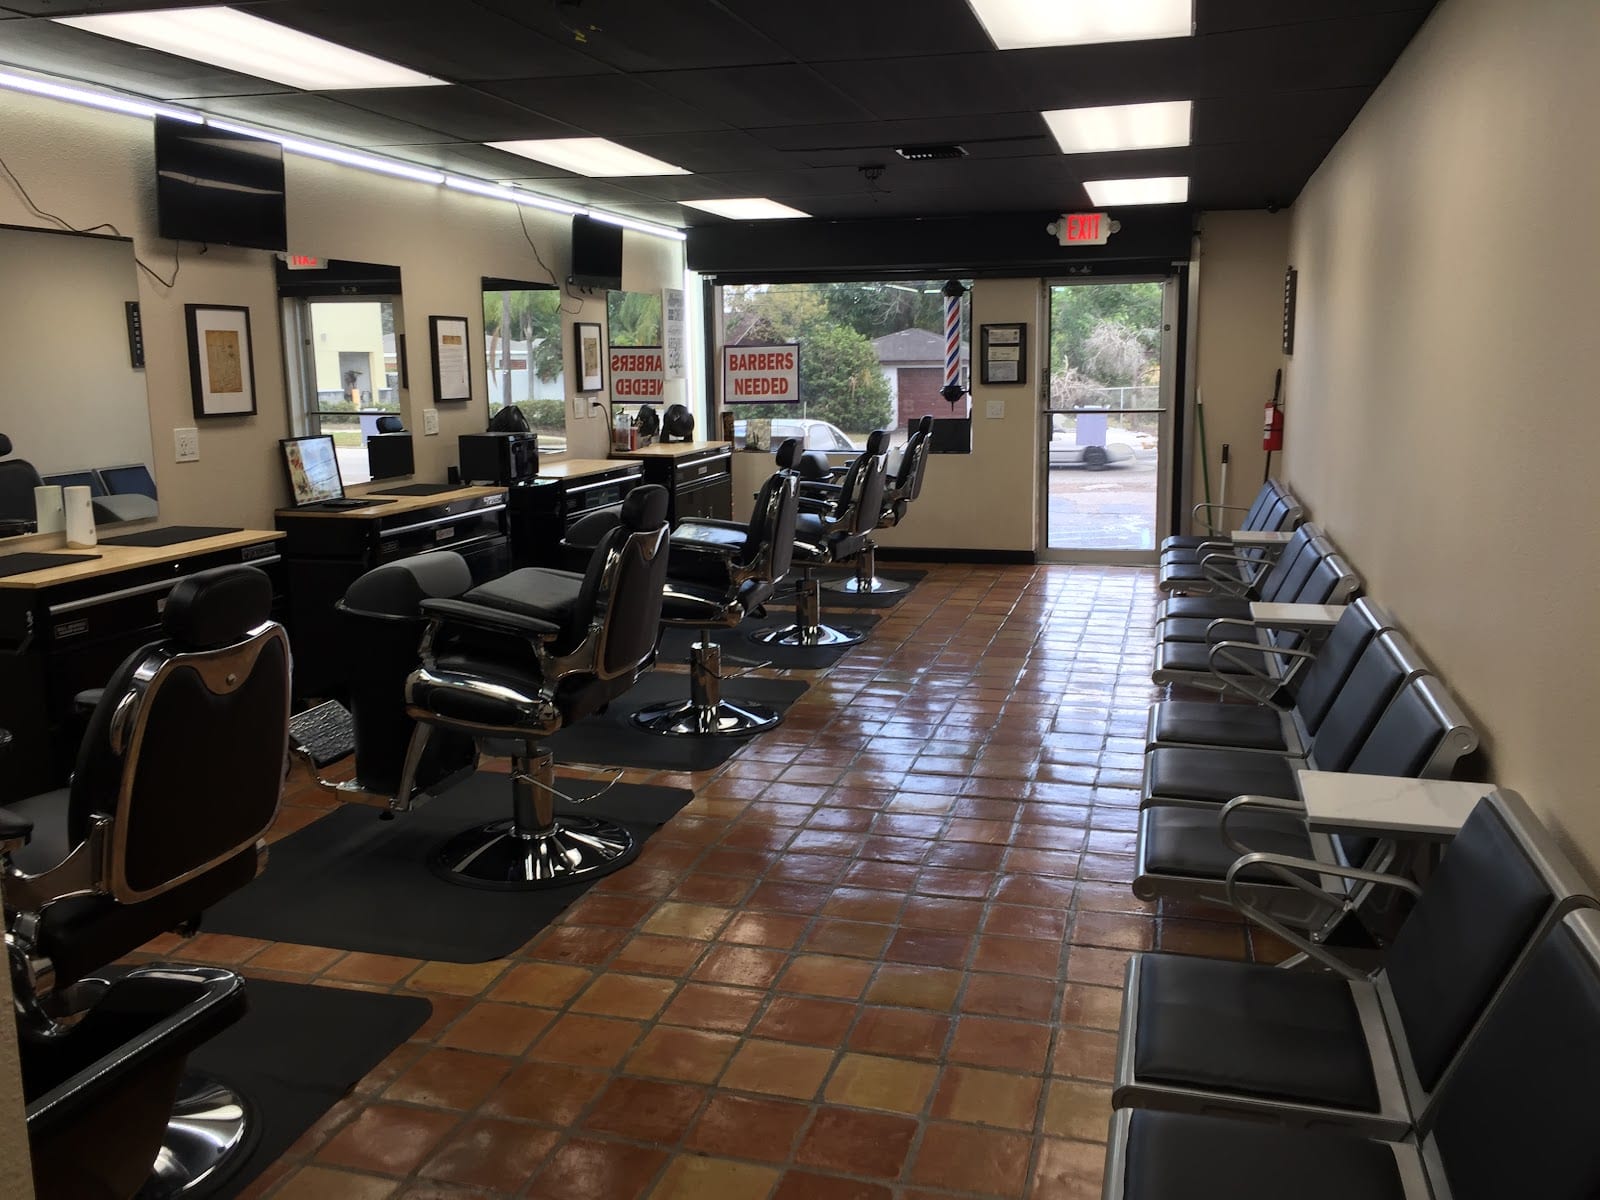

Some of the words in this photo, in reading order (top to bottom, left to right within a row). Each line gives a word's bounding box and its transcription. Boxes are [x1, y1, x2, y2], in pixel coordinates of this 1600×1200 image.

[1067, 214, 1101, 240] EXIT
[729, 352, 794, 371] BARBERS
[734, 377, 789, 395] NEEDED
